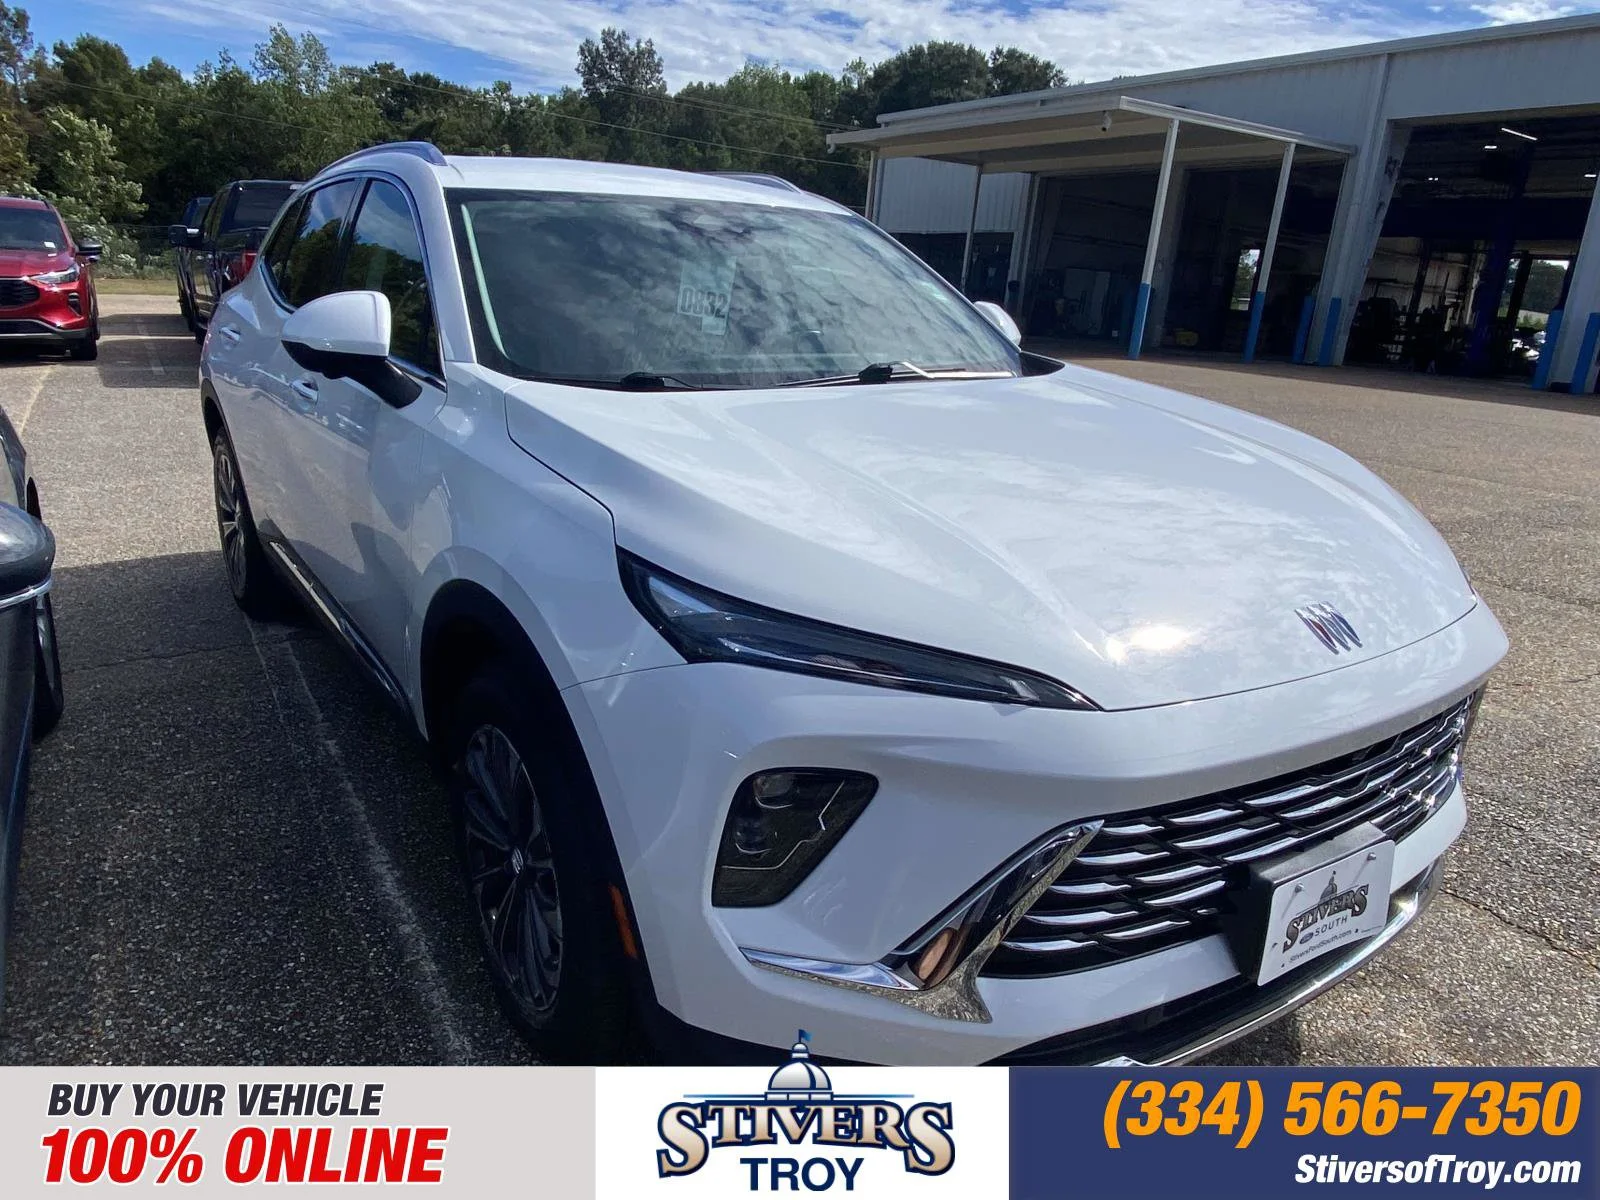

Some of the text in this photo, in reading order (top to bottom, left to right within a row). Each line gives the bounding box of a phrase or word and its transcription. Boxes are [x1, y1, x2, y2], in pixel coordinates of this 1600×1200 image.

[679, 286, 729, 319] 0832
[1281, 884, 1370, 954] STIVERS
[1314, 916, 1348, 937] SOUTH
